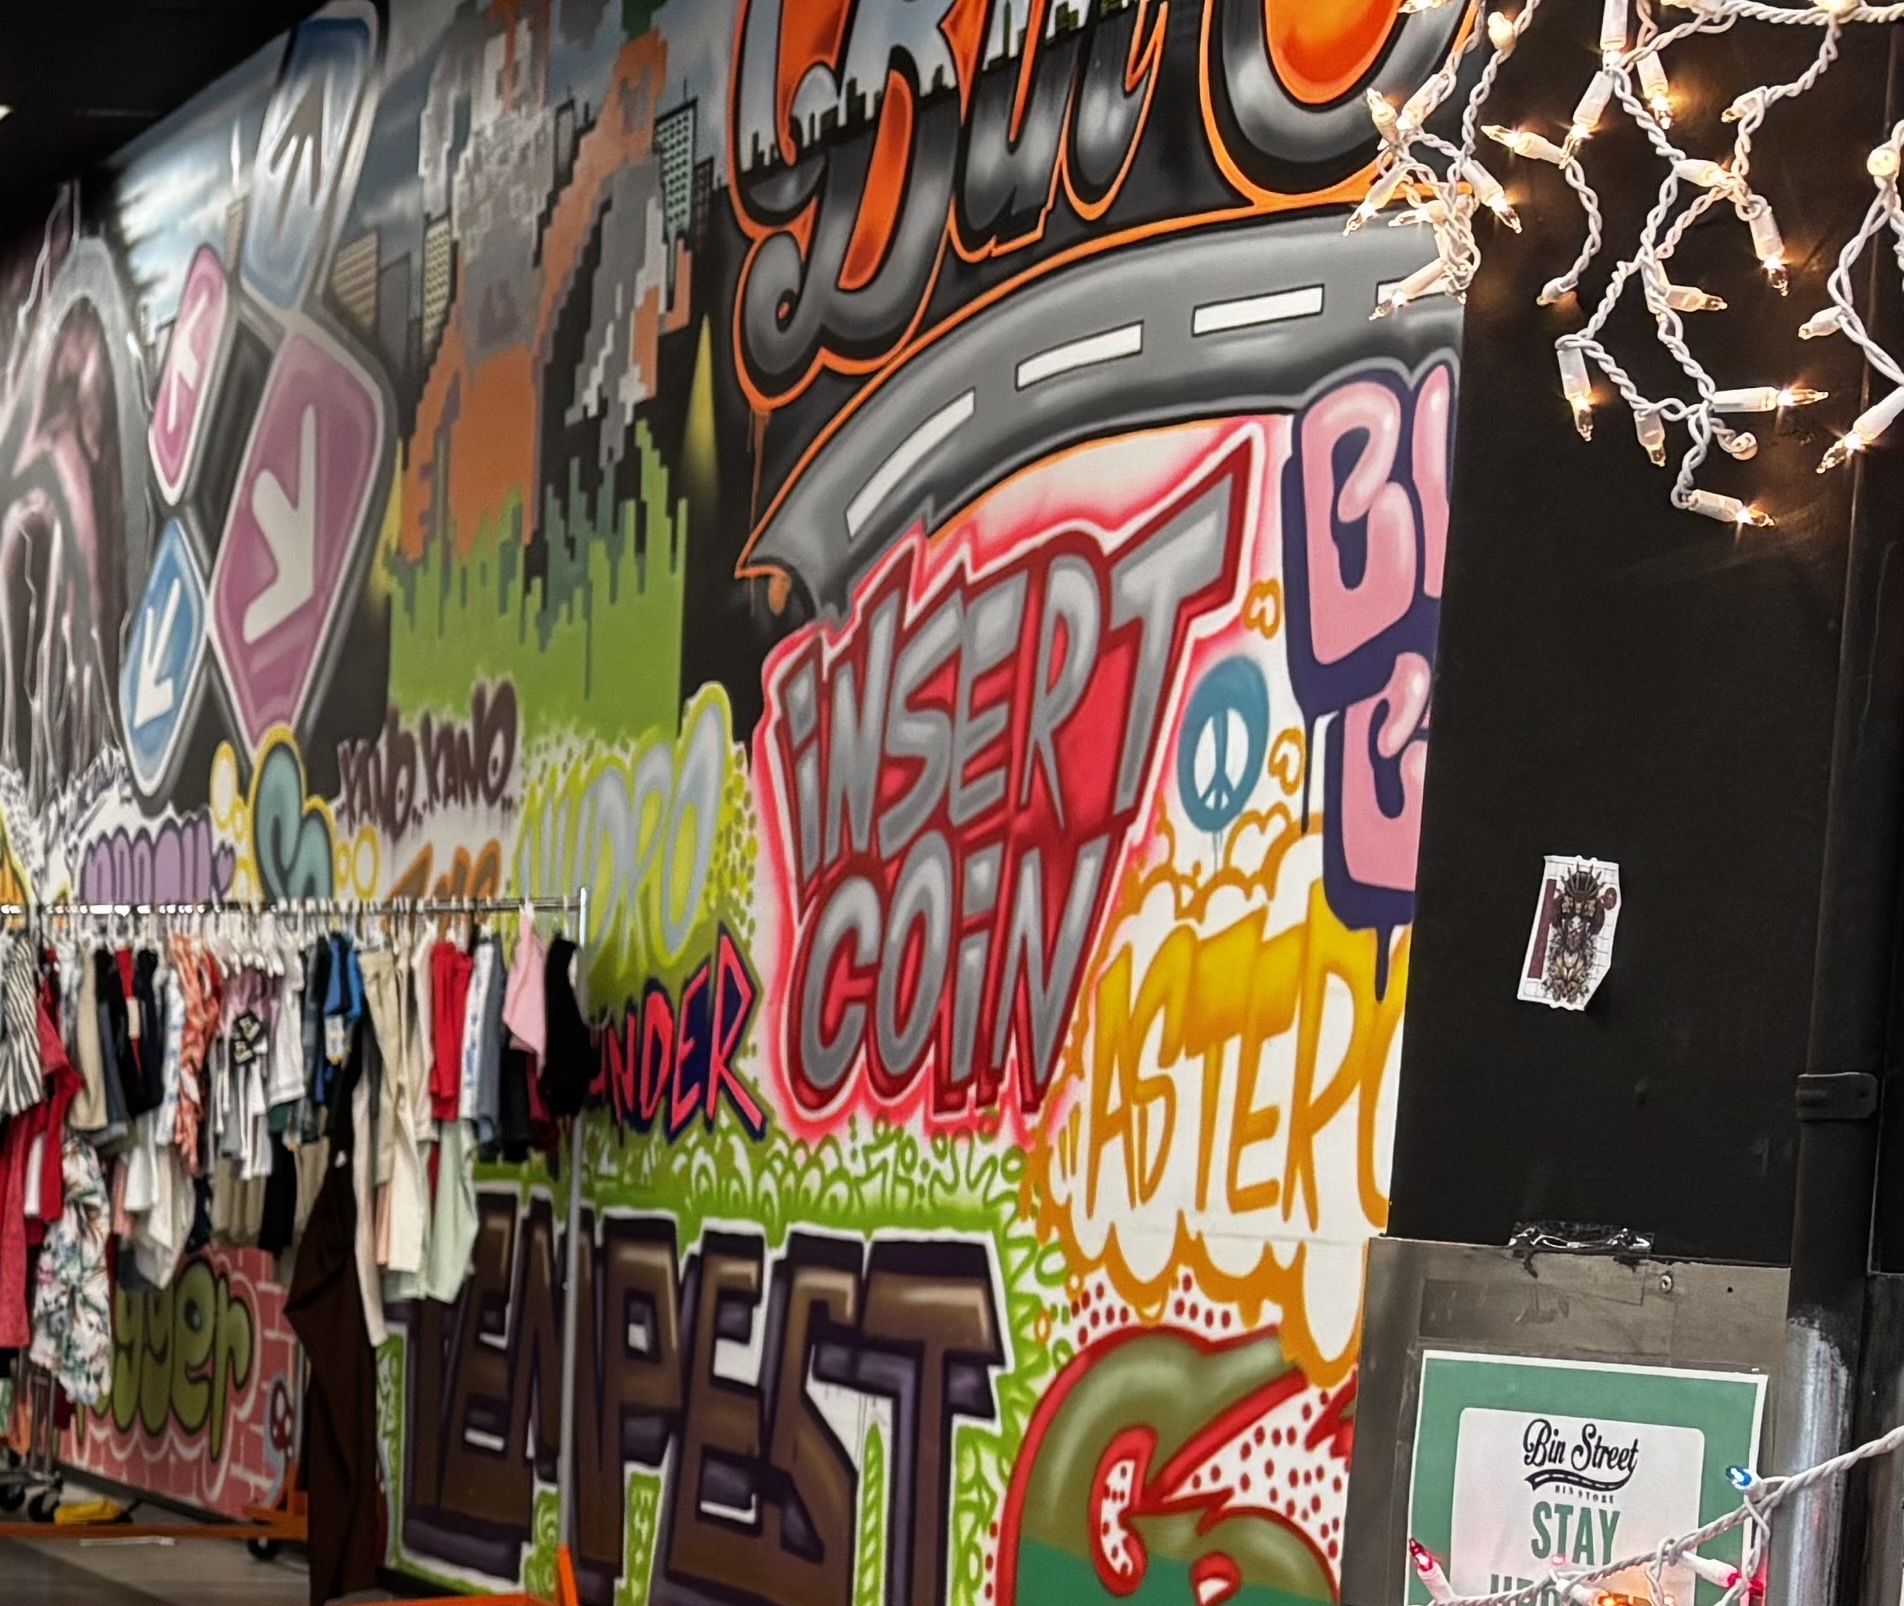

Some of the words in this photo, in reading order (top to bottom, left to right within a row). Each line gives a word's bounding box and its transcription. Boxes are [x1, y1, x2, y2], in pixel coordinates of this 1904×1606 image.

[787, 480, 1227, 876] INSERT
[796, 835, 1104, 1094] COIN
[1523, 1418, 1566, 1467] Bin
[1571, 1423, 1639, 1472] Street
[1531, 1501, 1620, 1566] STAY
